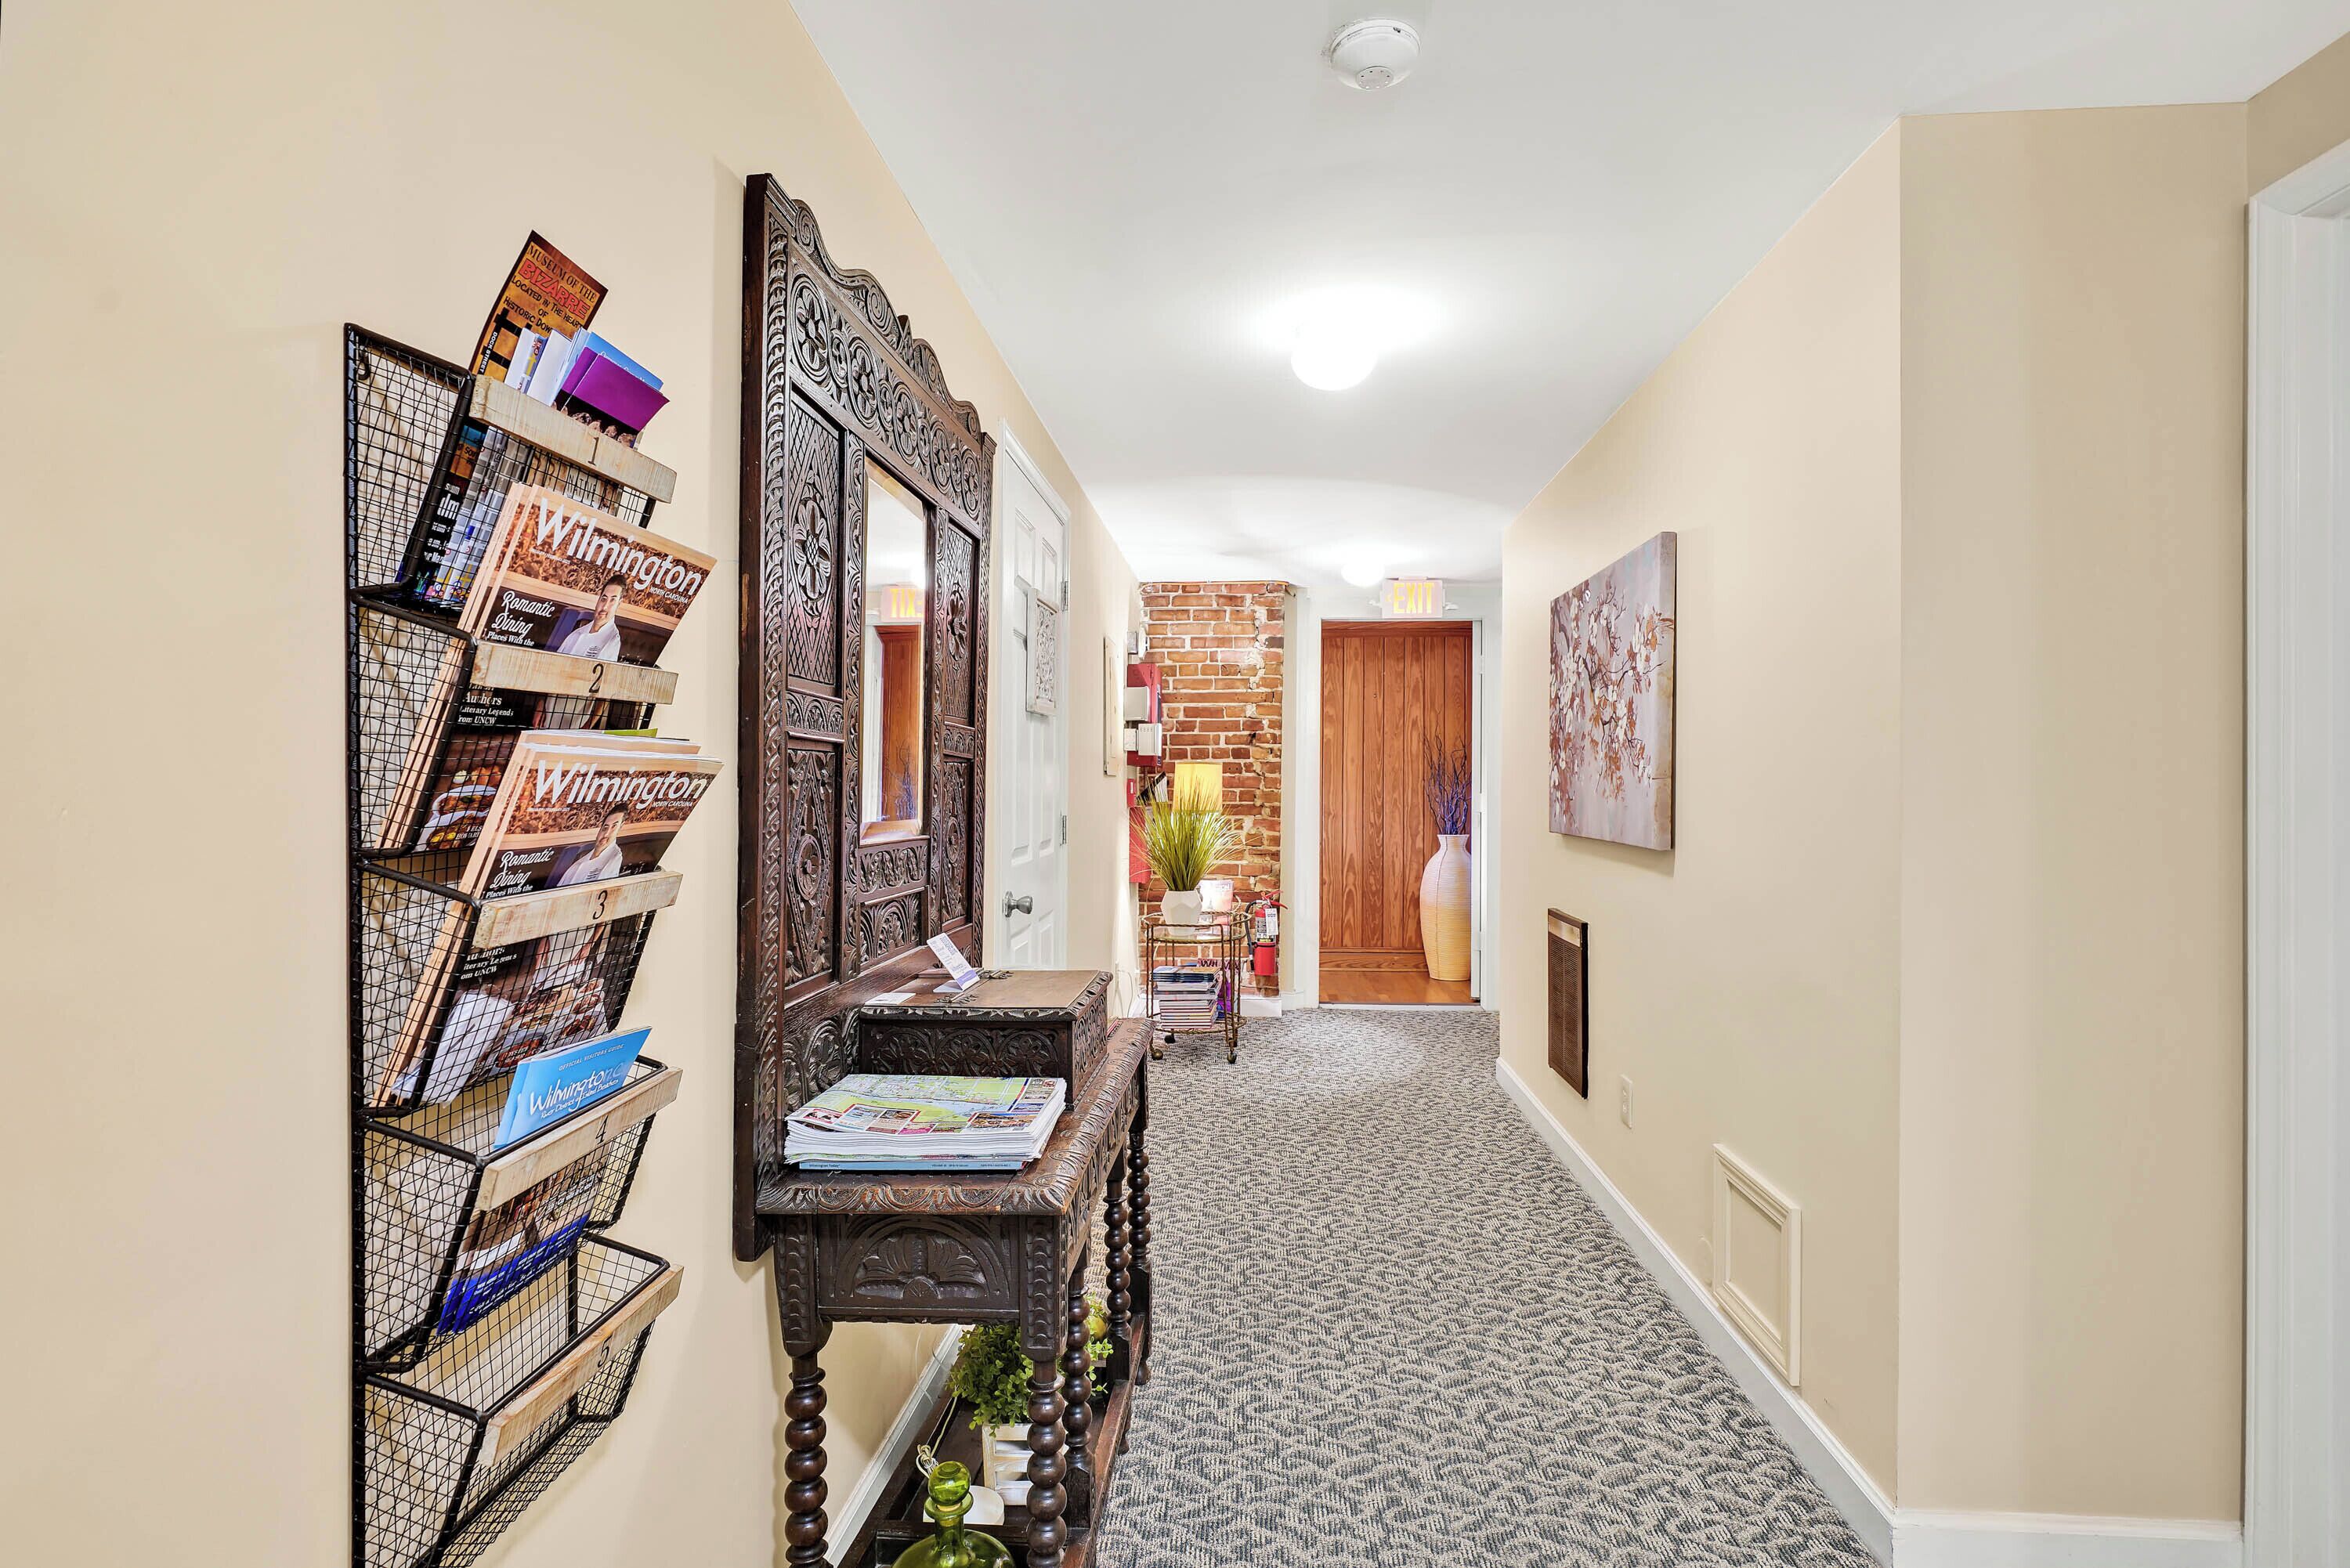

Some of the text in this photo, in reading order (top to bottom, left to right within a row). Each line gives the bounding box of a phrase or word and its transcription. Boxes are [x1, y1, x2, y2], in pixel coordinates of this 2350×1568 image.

[527, 245, 597, 303] MUSEUM OF THE
[519, 258, 591, 320] BIZARRE
[512, 276, 542, 301] LOCATED
[551, 302, 563, 316] THE
[563, 313, 584, 329] HEART
[537, 309, 549, 318] OF
[536, 318, 554, 334] DOW
[479, 331, 498, 374] DOCK STREET
[588, 437, 599, 466] 1
[537, 497, 703, 596] Wilmington
[501, 591, 555, 618] Romantic
[649, 587, 689, 603] NORTH CAROLINA
[1393, 582, 1434, 614] EXIT
[491, 612, 533, 638] Dining
[486, 630, 534, 647] Places With the
[589, 663, 604, 693] 2
[459, 706, 515, 717] Literary Legends
[465, 691, 502, 706] Authors
[474, 716, 497, 724] UNCW
[535, 760, 707, 810] Wilmington
[500, 847, 555, 873] Romantic
[490, 869, 531, 890] Dining
[486, 889, 506, 898] Places
[593, 890, 608, 919] 3
[463, 960, 490, 970] iterary
[474, 966, 497, 977] UNCW
[559, 1058, 582, 1071] OFFICIAL
[595, 1115, 609, 1144] 4
[598, 1334, 613, 1367] 5
